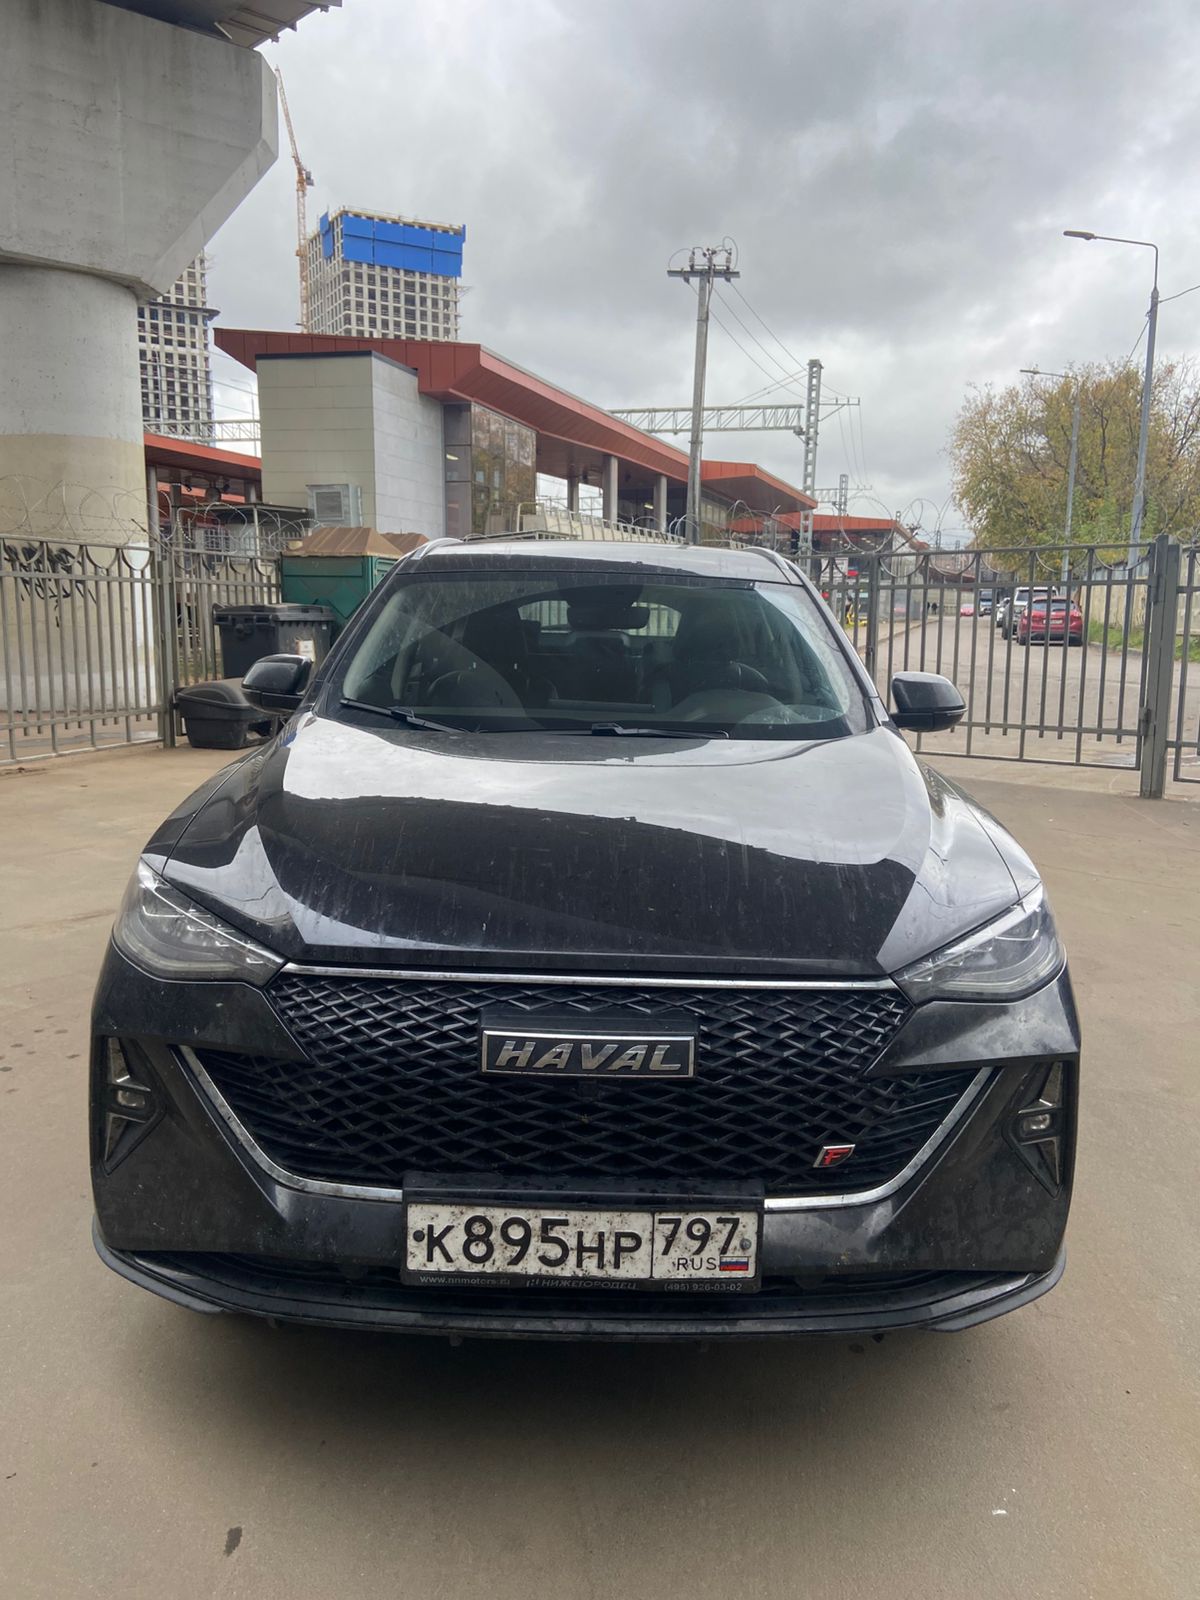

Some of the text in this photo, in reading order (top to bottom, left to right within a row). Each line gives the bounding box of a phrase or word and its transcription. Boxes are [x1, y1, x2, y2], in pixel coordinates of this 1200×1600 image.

[495, 1040, 682, 1071] HAVAL
[426, 1214, 741, 1270] К895НР 797
[676, 1256, 718, 1271] RUS
